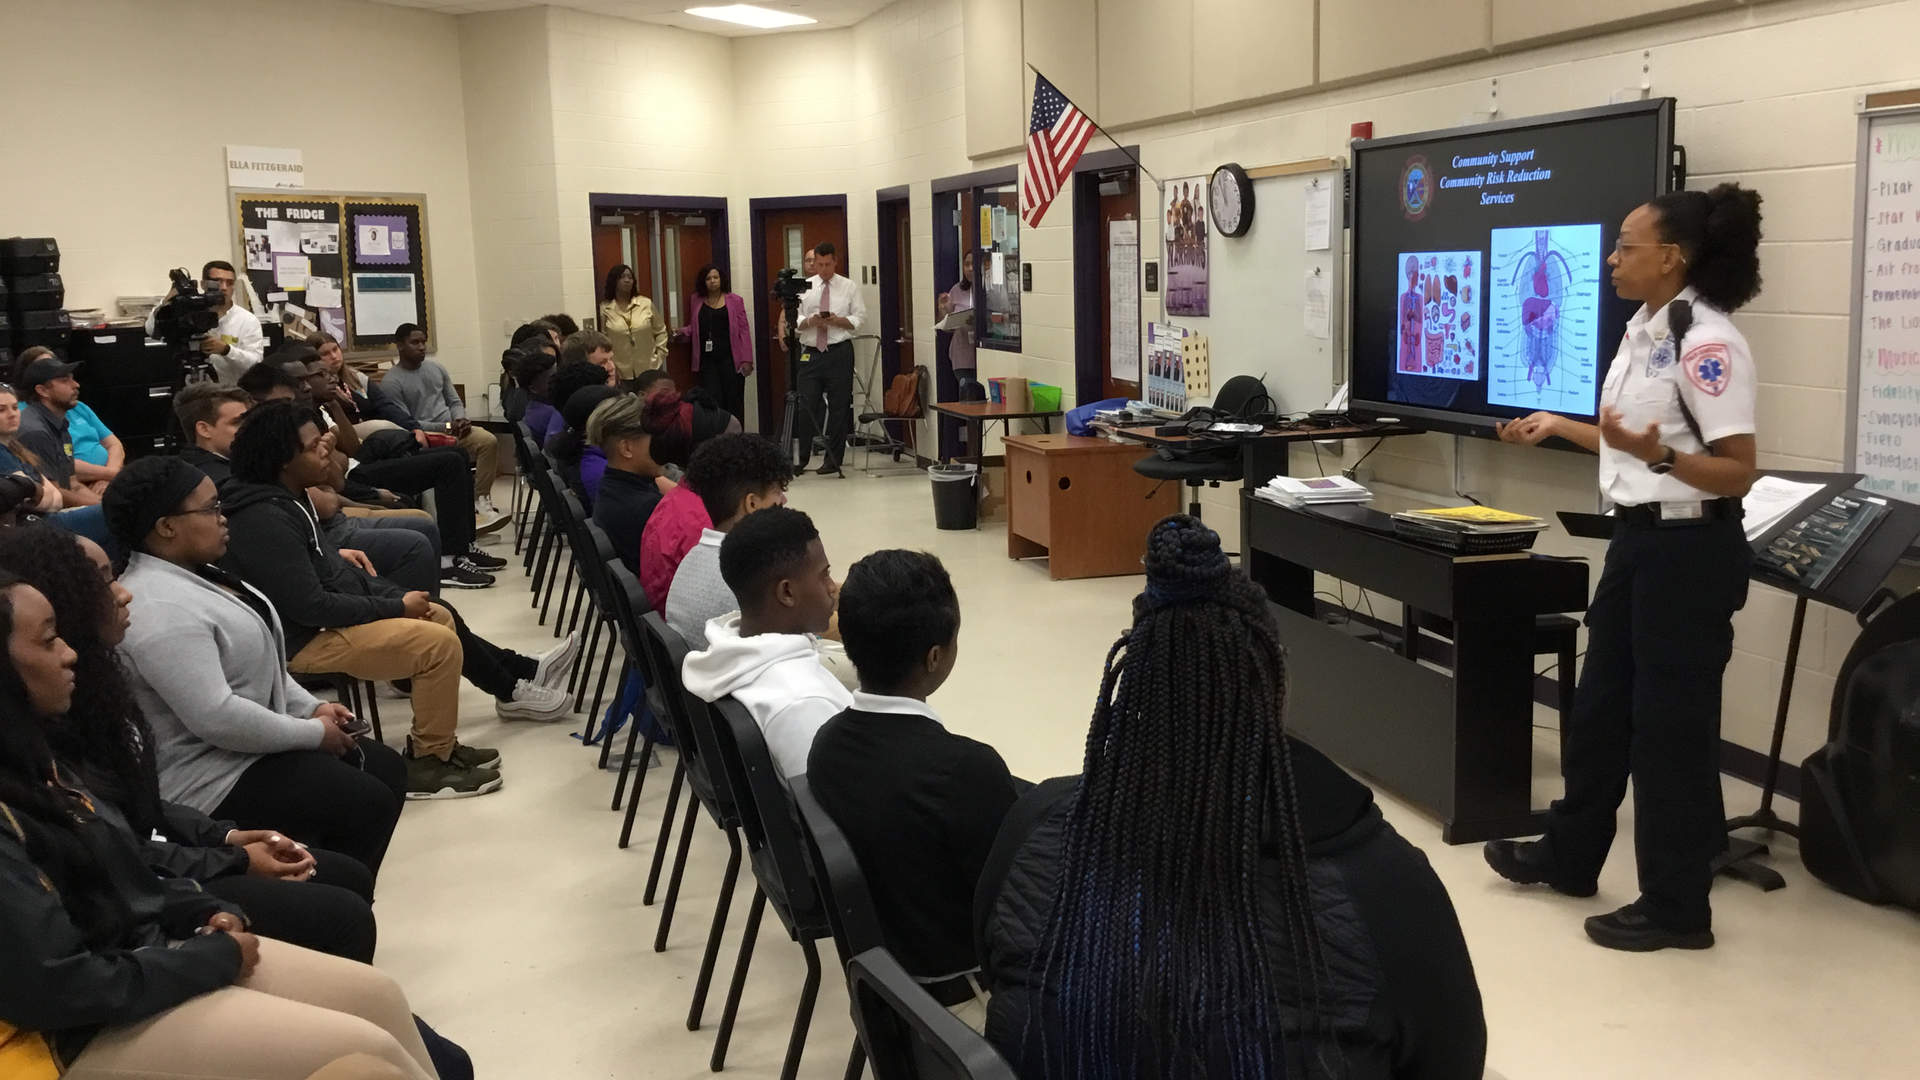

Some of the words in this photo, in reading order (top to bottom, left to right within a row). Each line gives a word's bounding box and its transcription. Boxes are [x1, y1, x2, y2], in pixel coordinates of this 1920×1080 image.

[229, 160, 249, 170] ELLA
[1452, 152, 1498, 168] Community
[1500, 149, 1535, 165] Support
[1440, 173, 1485, 188] Community
[1486, 171, 1505, 185] Risk
[1507, 167, 1551, 183] Reduction
[1480, 191, 1515, 205] Services
[255, 207, 278, 218] THE
[286, 208, 325, 220] FRIDGE
[1877, 211, 1904, 225] Star
[1870, 316, 1892, 330] The
